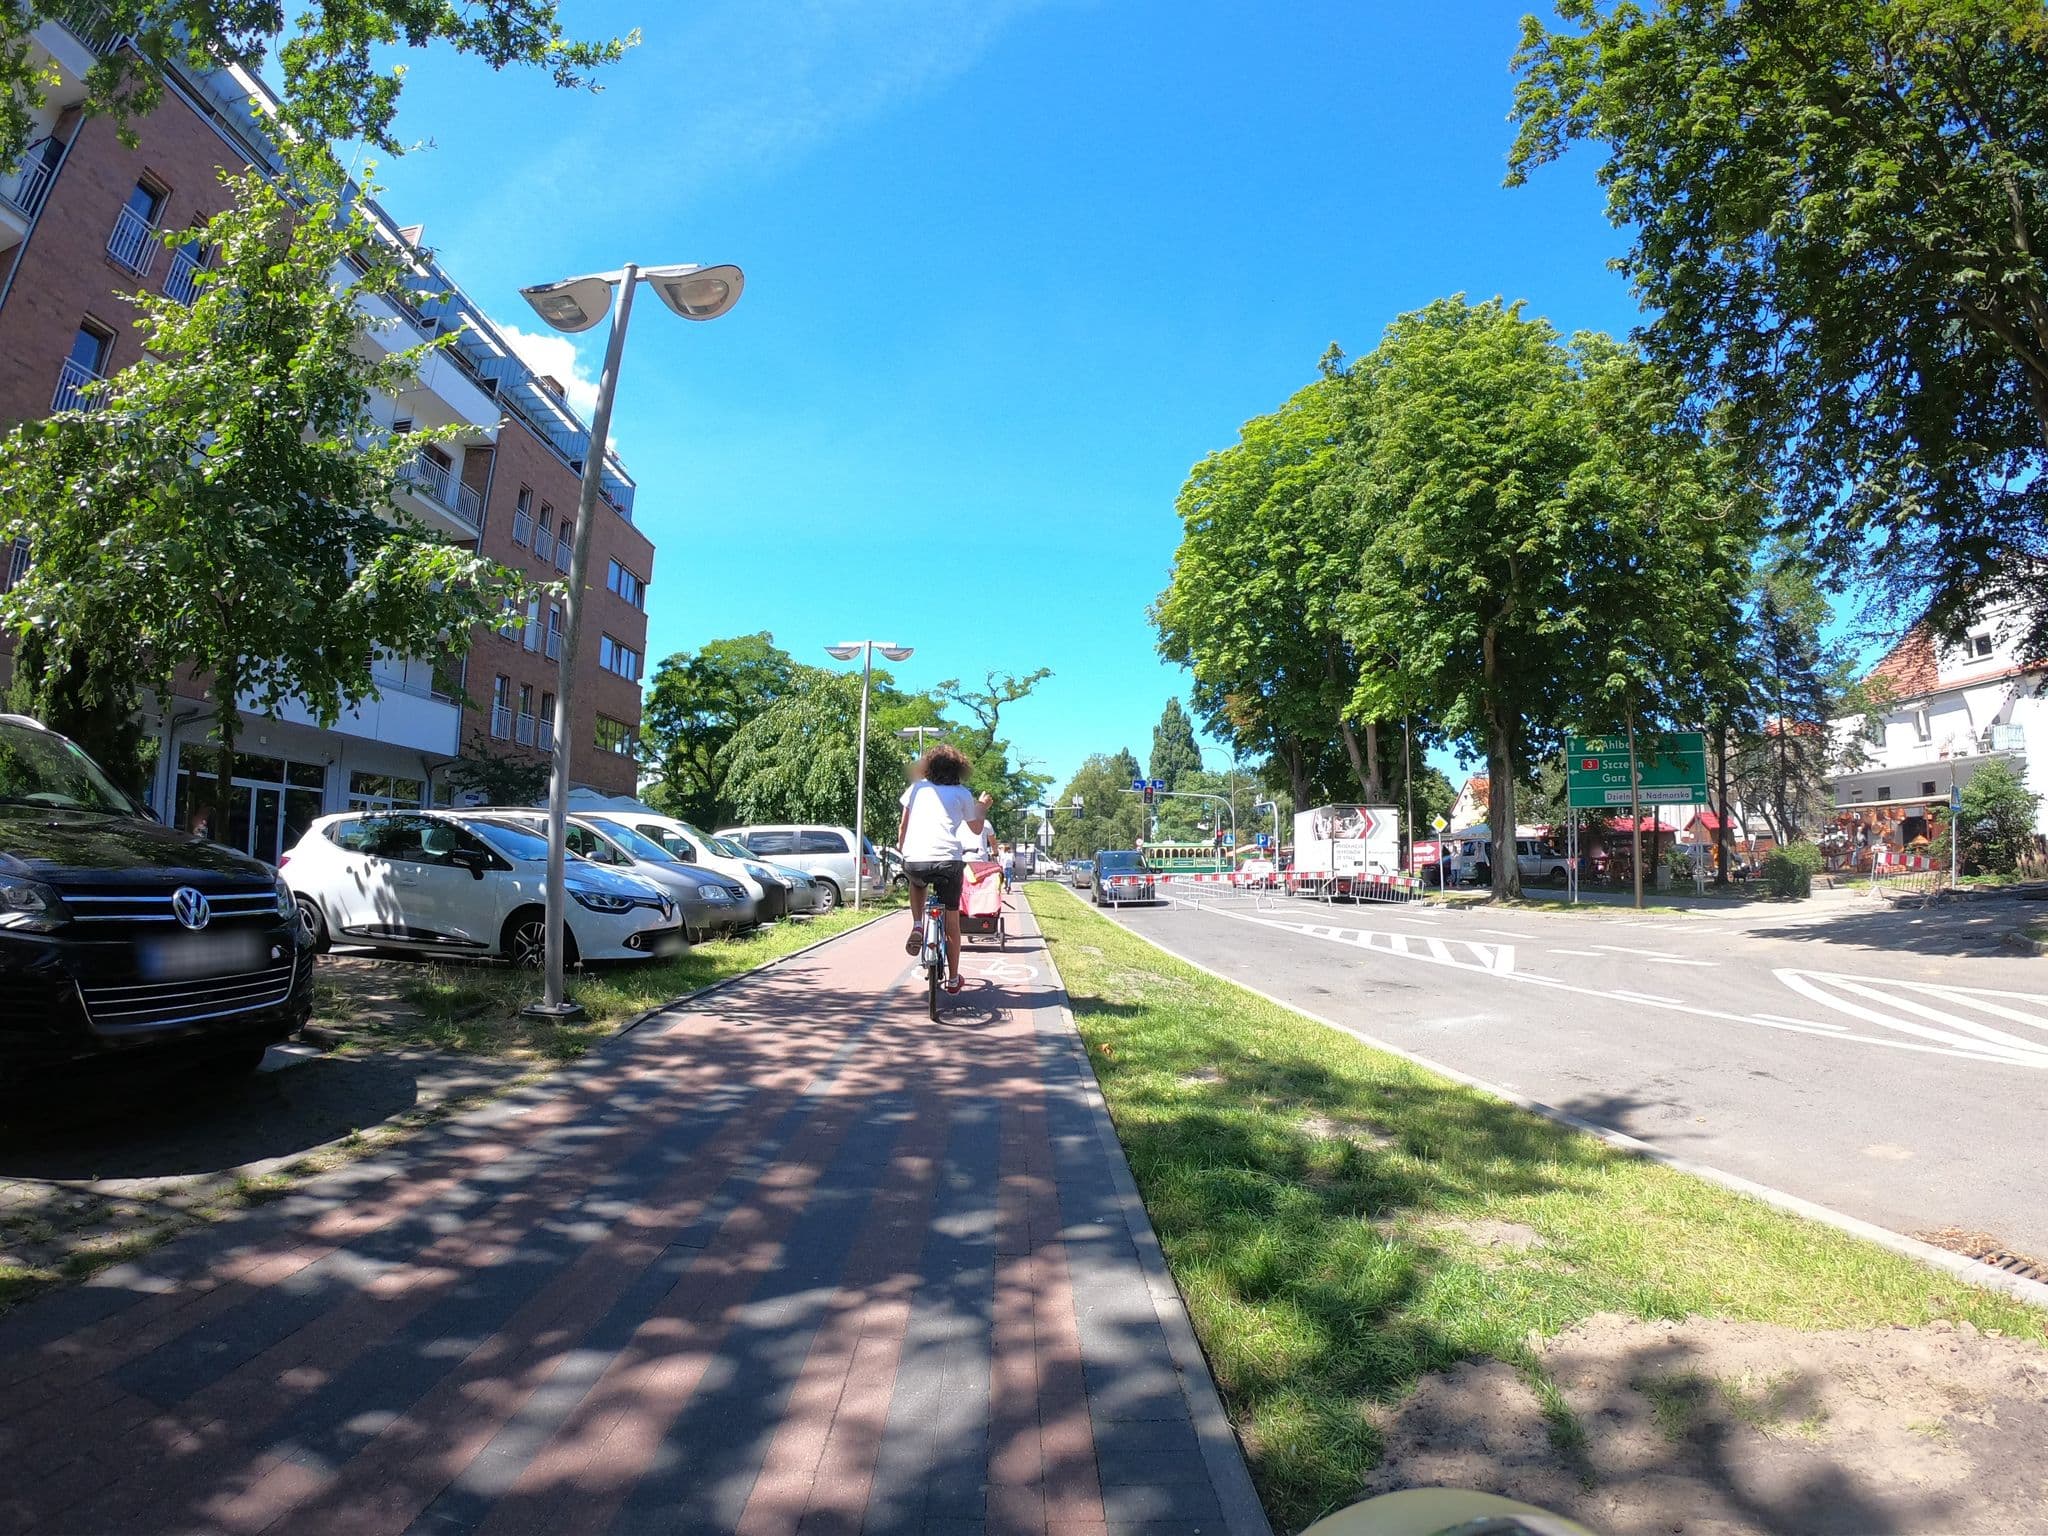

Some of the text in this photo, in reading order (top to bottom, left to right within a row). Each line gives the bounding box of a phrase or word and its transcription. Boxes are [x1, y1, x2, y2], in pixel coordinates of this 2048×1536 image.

[1602, 773, 1626, 783] Garz
[1607, 791, 1689, 801] Dzielna Nadmorska
